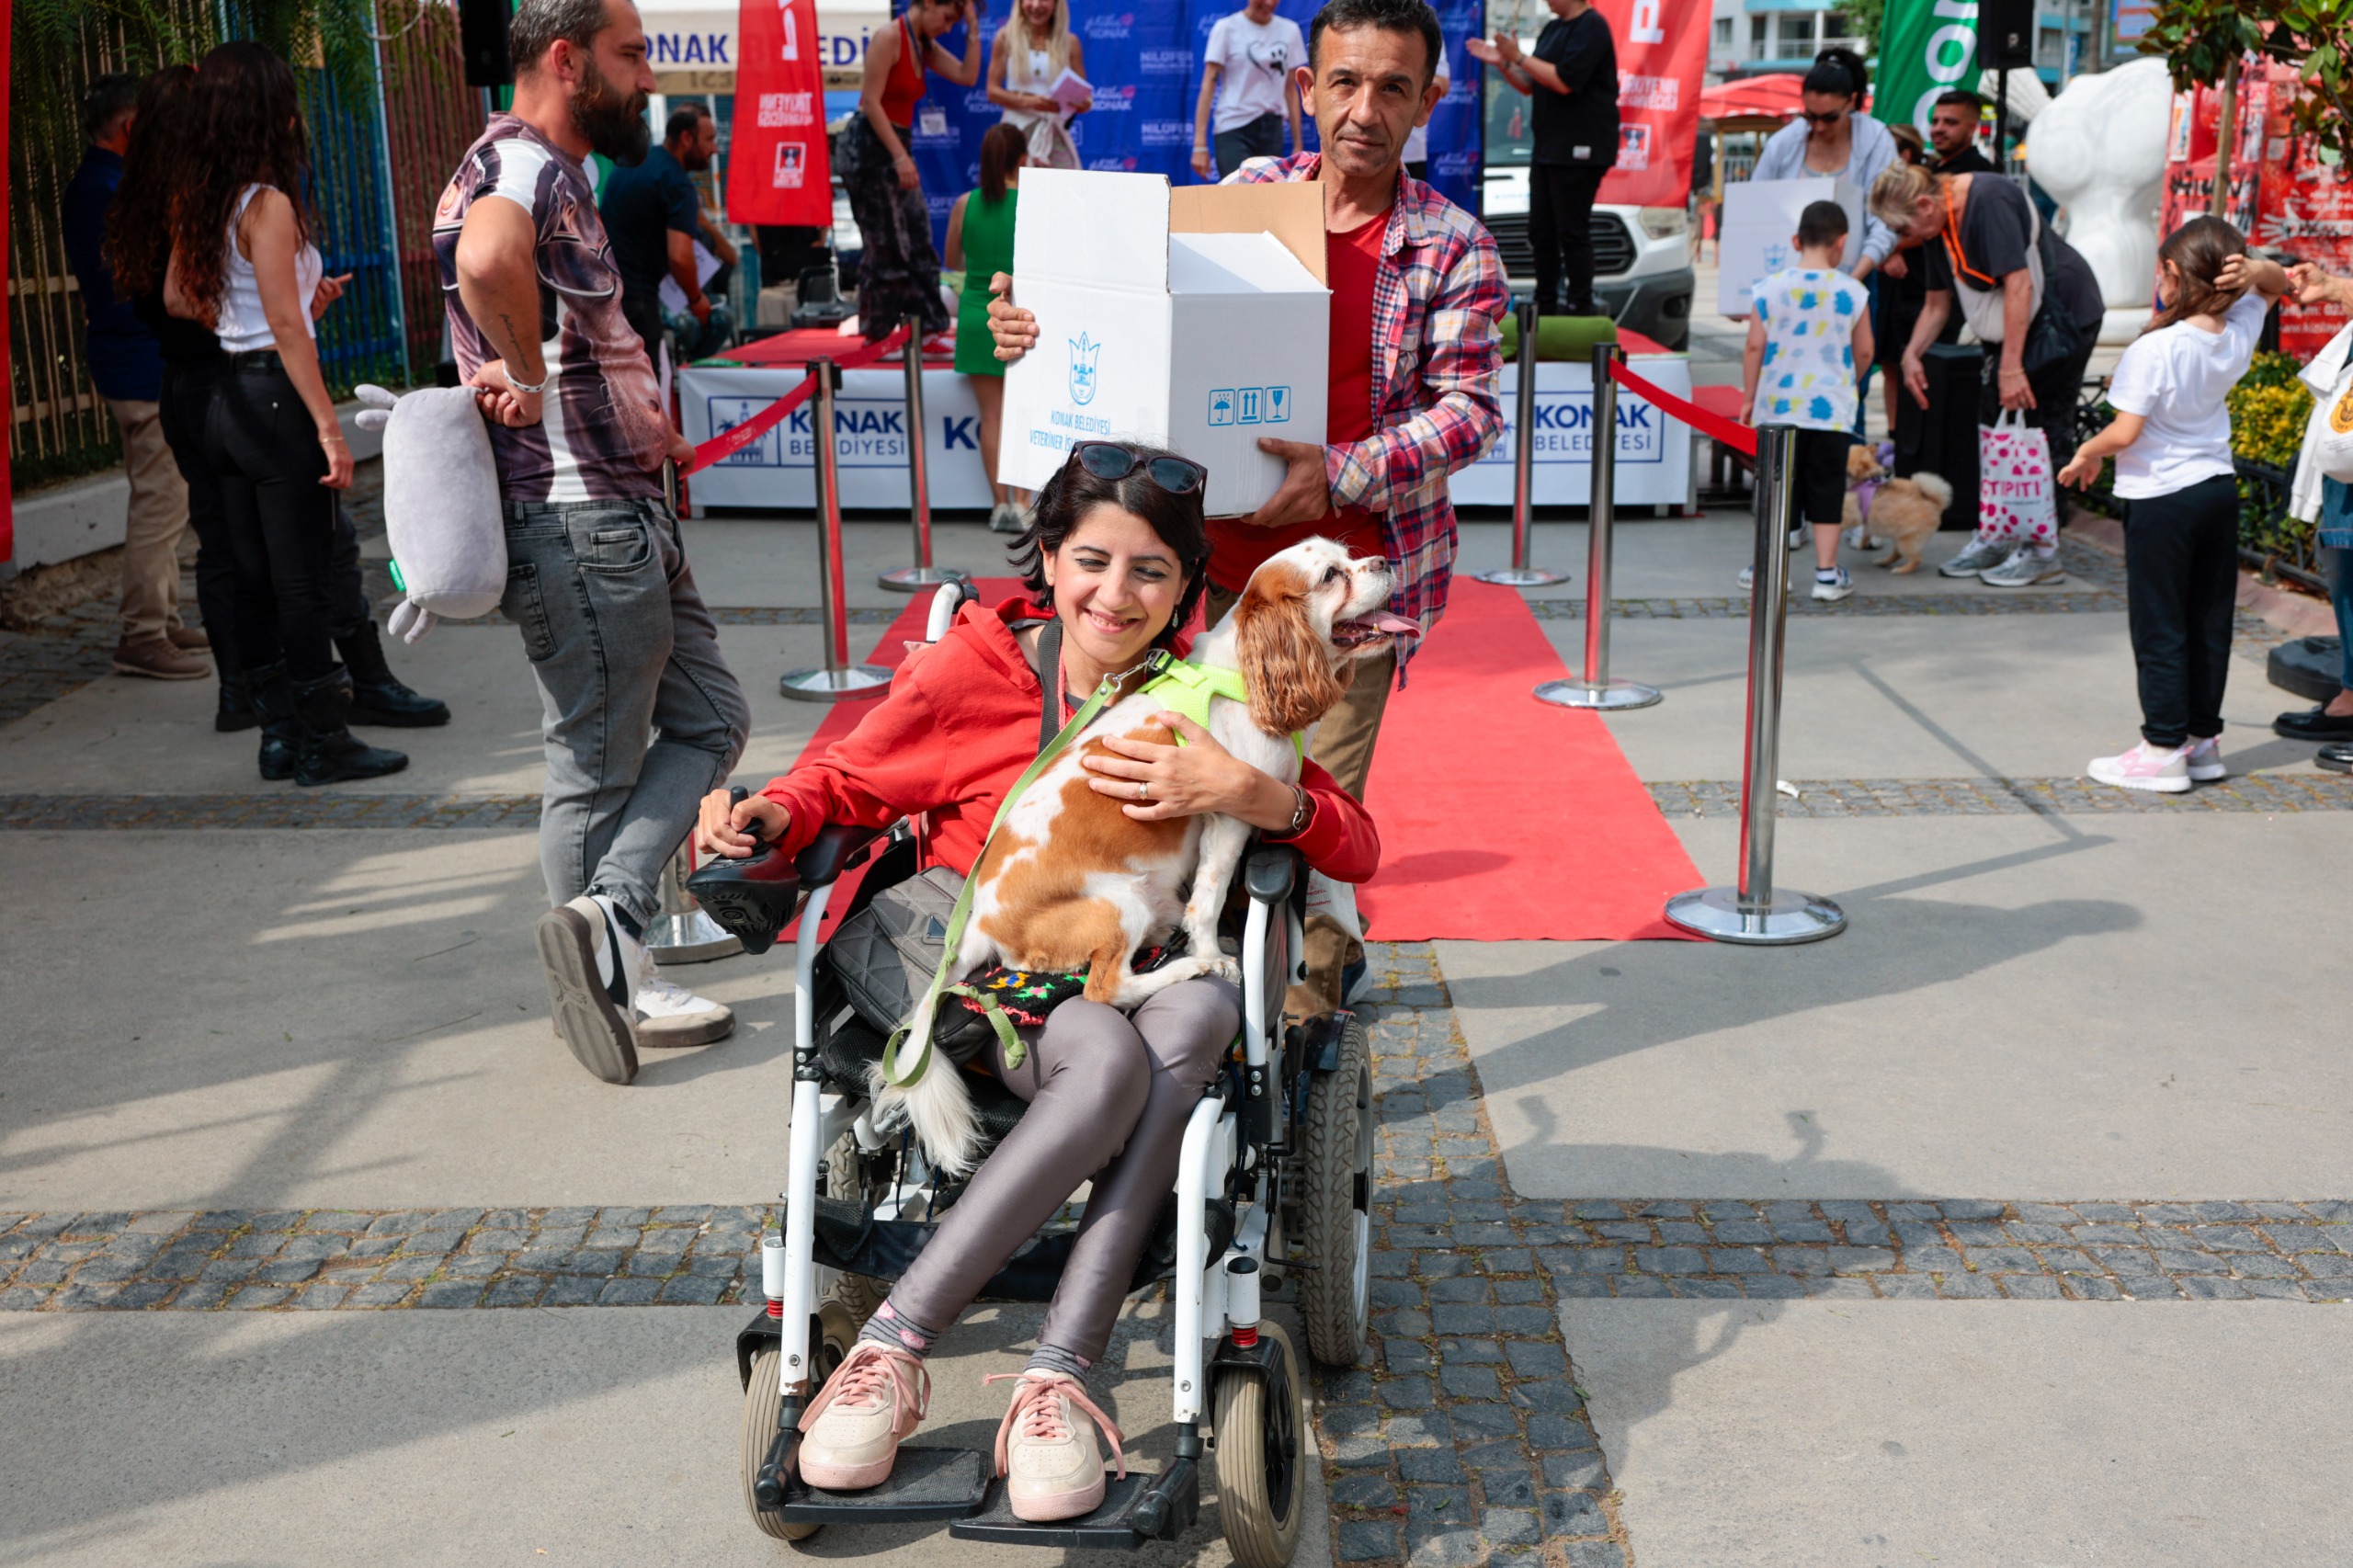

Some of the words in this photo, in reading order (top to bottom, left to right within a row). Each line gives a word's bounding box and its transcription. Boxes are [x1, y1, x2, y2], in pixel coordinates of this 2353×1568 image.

[644, 34, 729, 64] NAK
[790, 410, 904, 434] KNAK
[1051, 410, 1074, 428] KONAK
[1074, 415, 1111, 437] BELEDİYESİ
[790, 435, 905, 456] BEDİYESİ
[1029, 428, 1064, 450] VETERİNER
[1535, 428, 1651, 451] BELEDESİ
